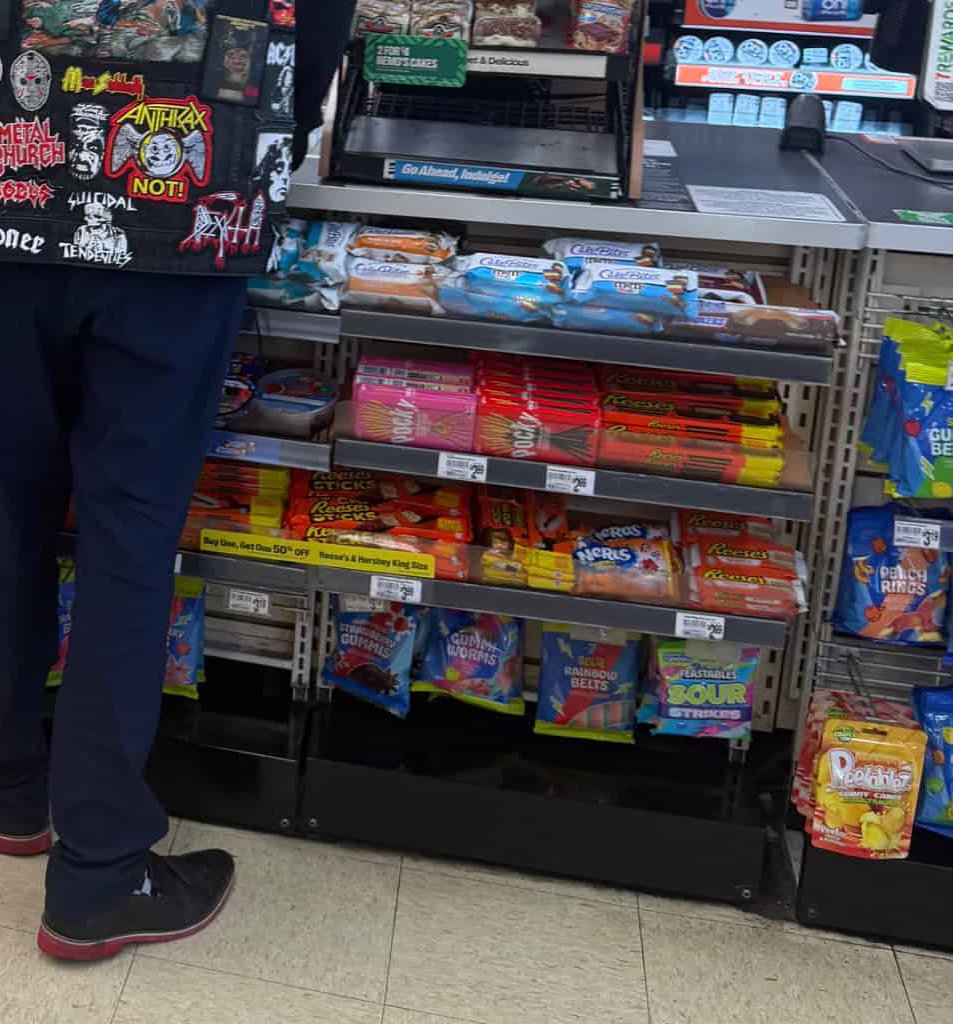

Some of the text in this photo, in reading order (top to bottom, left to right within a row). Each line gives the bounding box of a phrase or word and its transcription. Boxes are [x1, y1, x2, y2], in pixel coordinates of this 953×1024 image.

[487, 57, 530, 66] Delicious
[117, 102, 209, 134] ANTHRAX
[401, 163, 510, 185] Go Ahead, Indulge!
[132, 178, 185, 198] NOT!
[67, 191, 139, 212] SUICIDAL
[390, 398, 415, 444] POCKY
[510, 411, 542, 458] POCKY
[203, 536, 217, 547] Buy
[218, 538, 239, 550] One,
[240, 540, 254, 550] Get
[255, 542, 271, 552] One
[294, 547, 310, 557] OFF
[319, 550, 430, 572] Reese's & Hershey King Size
[880, 579, 927, 596] RINGS
[446, 645, 497, 667] WORMS
[564, 665, 618, 682] RAINBOW
[571, 676, 609, 692] BELTS
[677, 668, 738, 680] FEASTABLES
[665, 682, 748, 706] SOUR
[668, 706, 743, 721] STRIKES
